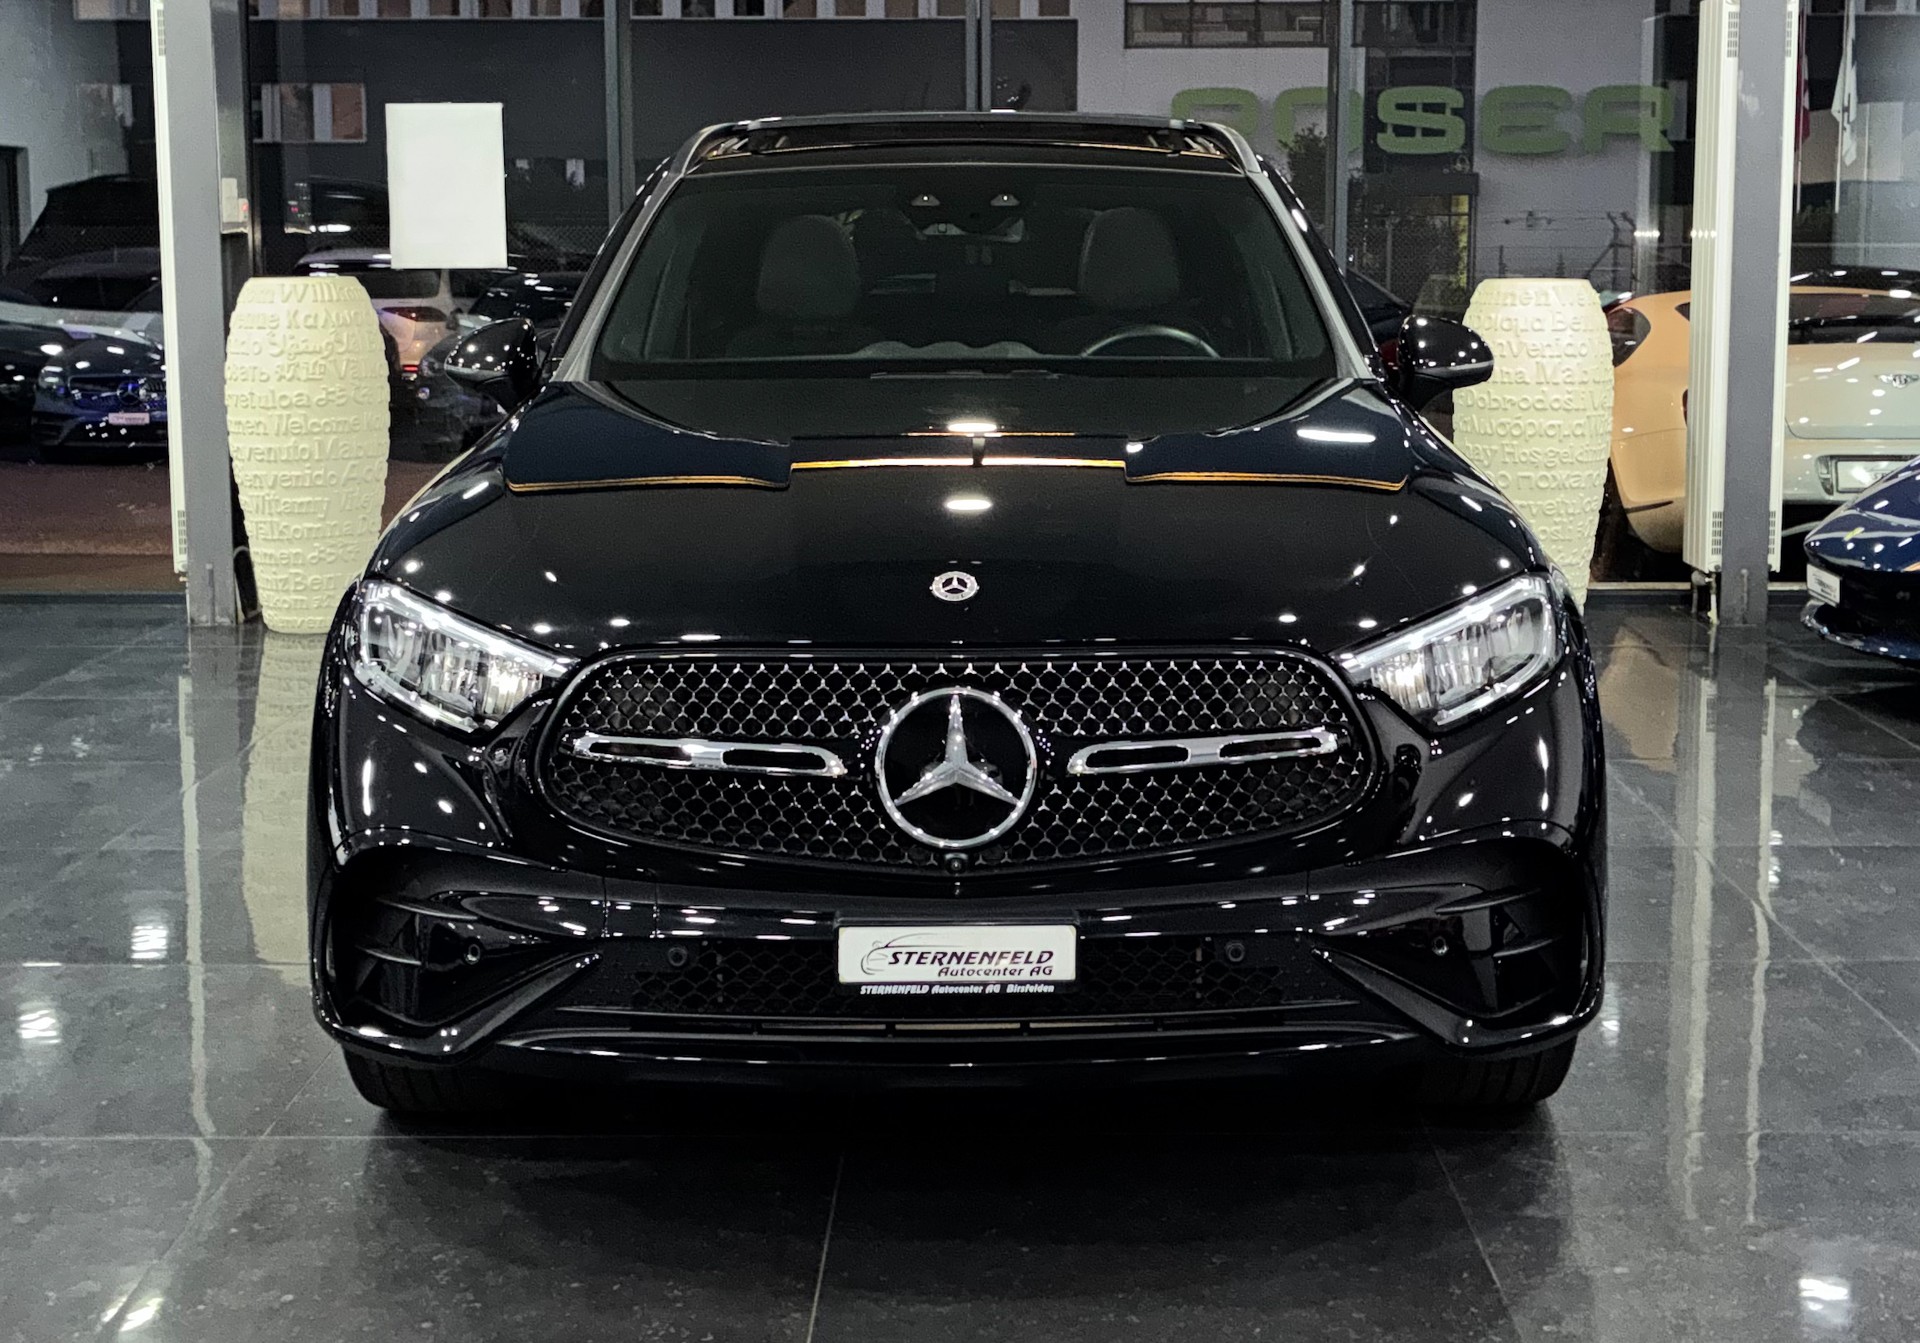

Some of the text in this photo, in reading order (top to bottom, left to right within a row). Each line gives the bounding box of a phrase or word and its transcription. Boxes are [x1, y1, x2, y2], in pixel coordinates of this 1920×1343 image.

[888, 950, 1054, 967] STERNENFELD
[938, 966, 1053, 977] Autocenter AG
[860, 984, 1055, 995] STERNENFELD Autocenter AG Birsfelden
